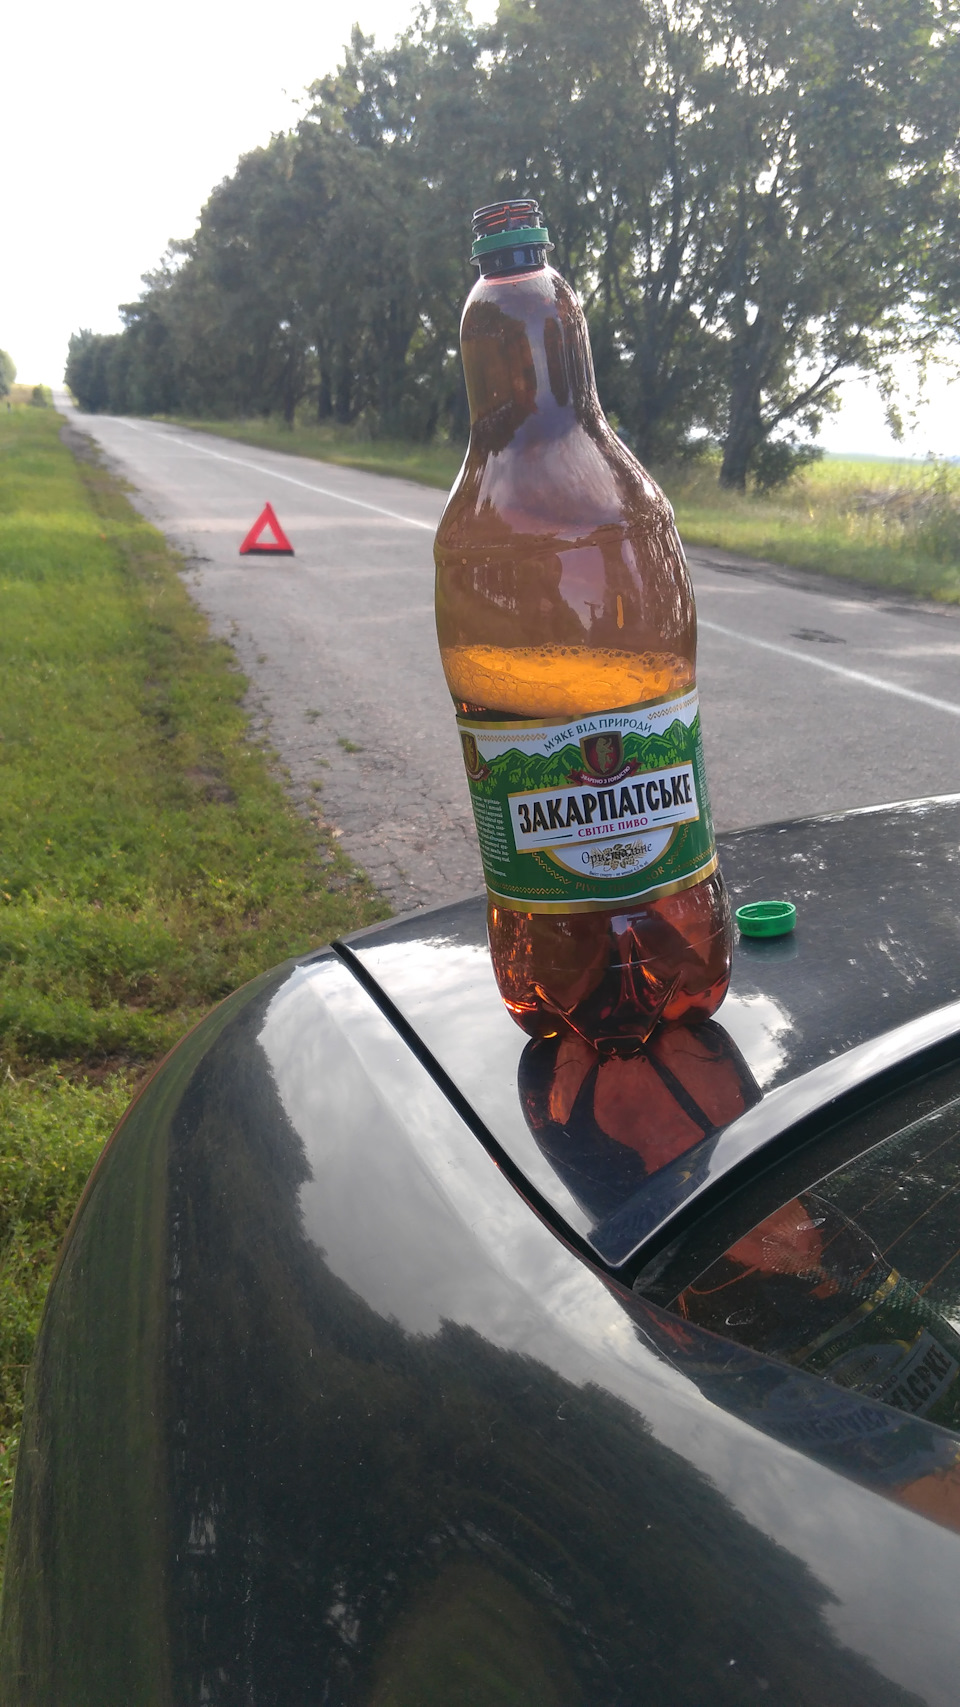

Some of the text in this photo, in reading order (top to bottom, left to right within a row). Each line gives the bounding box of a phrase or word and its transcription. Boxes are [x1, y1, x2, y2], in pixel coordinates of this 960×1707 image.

[543, 717, 653, 752] М'ЯКЕ ВІД ПРИРОДИ
[517, 773, 693, 834] ЗАКАРПАТСЬКЕ
[577, 817, 649, 838] СВІТЛЕ ПИВО
